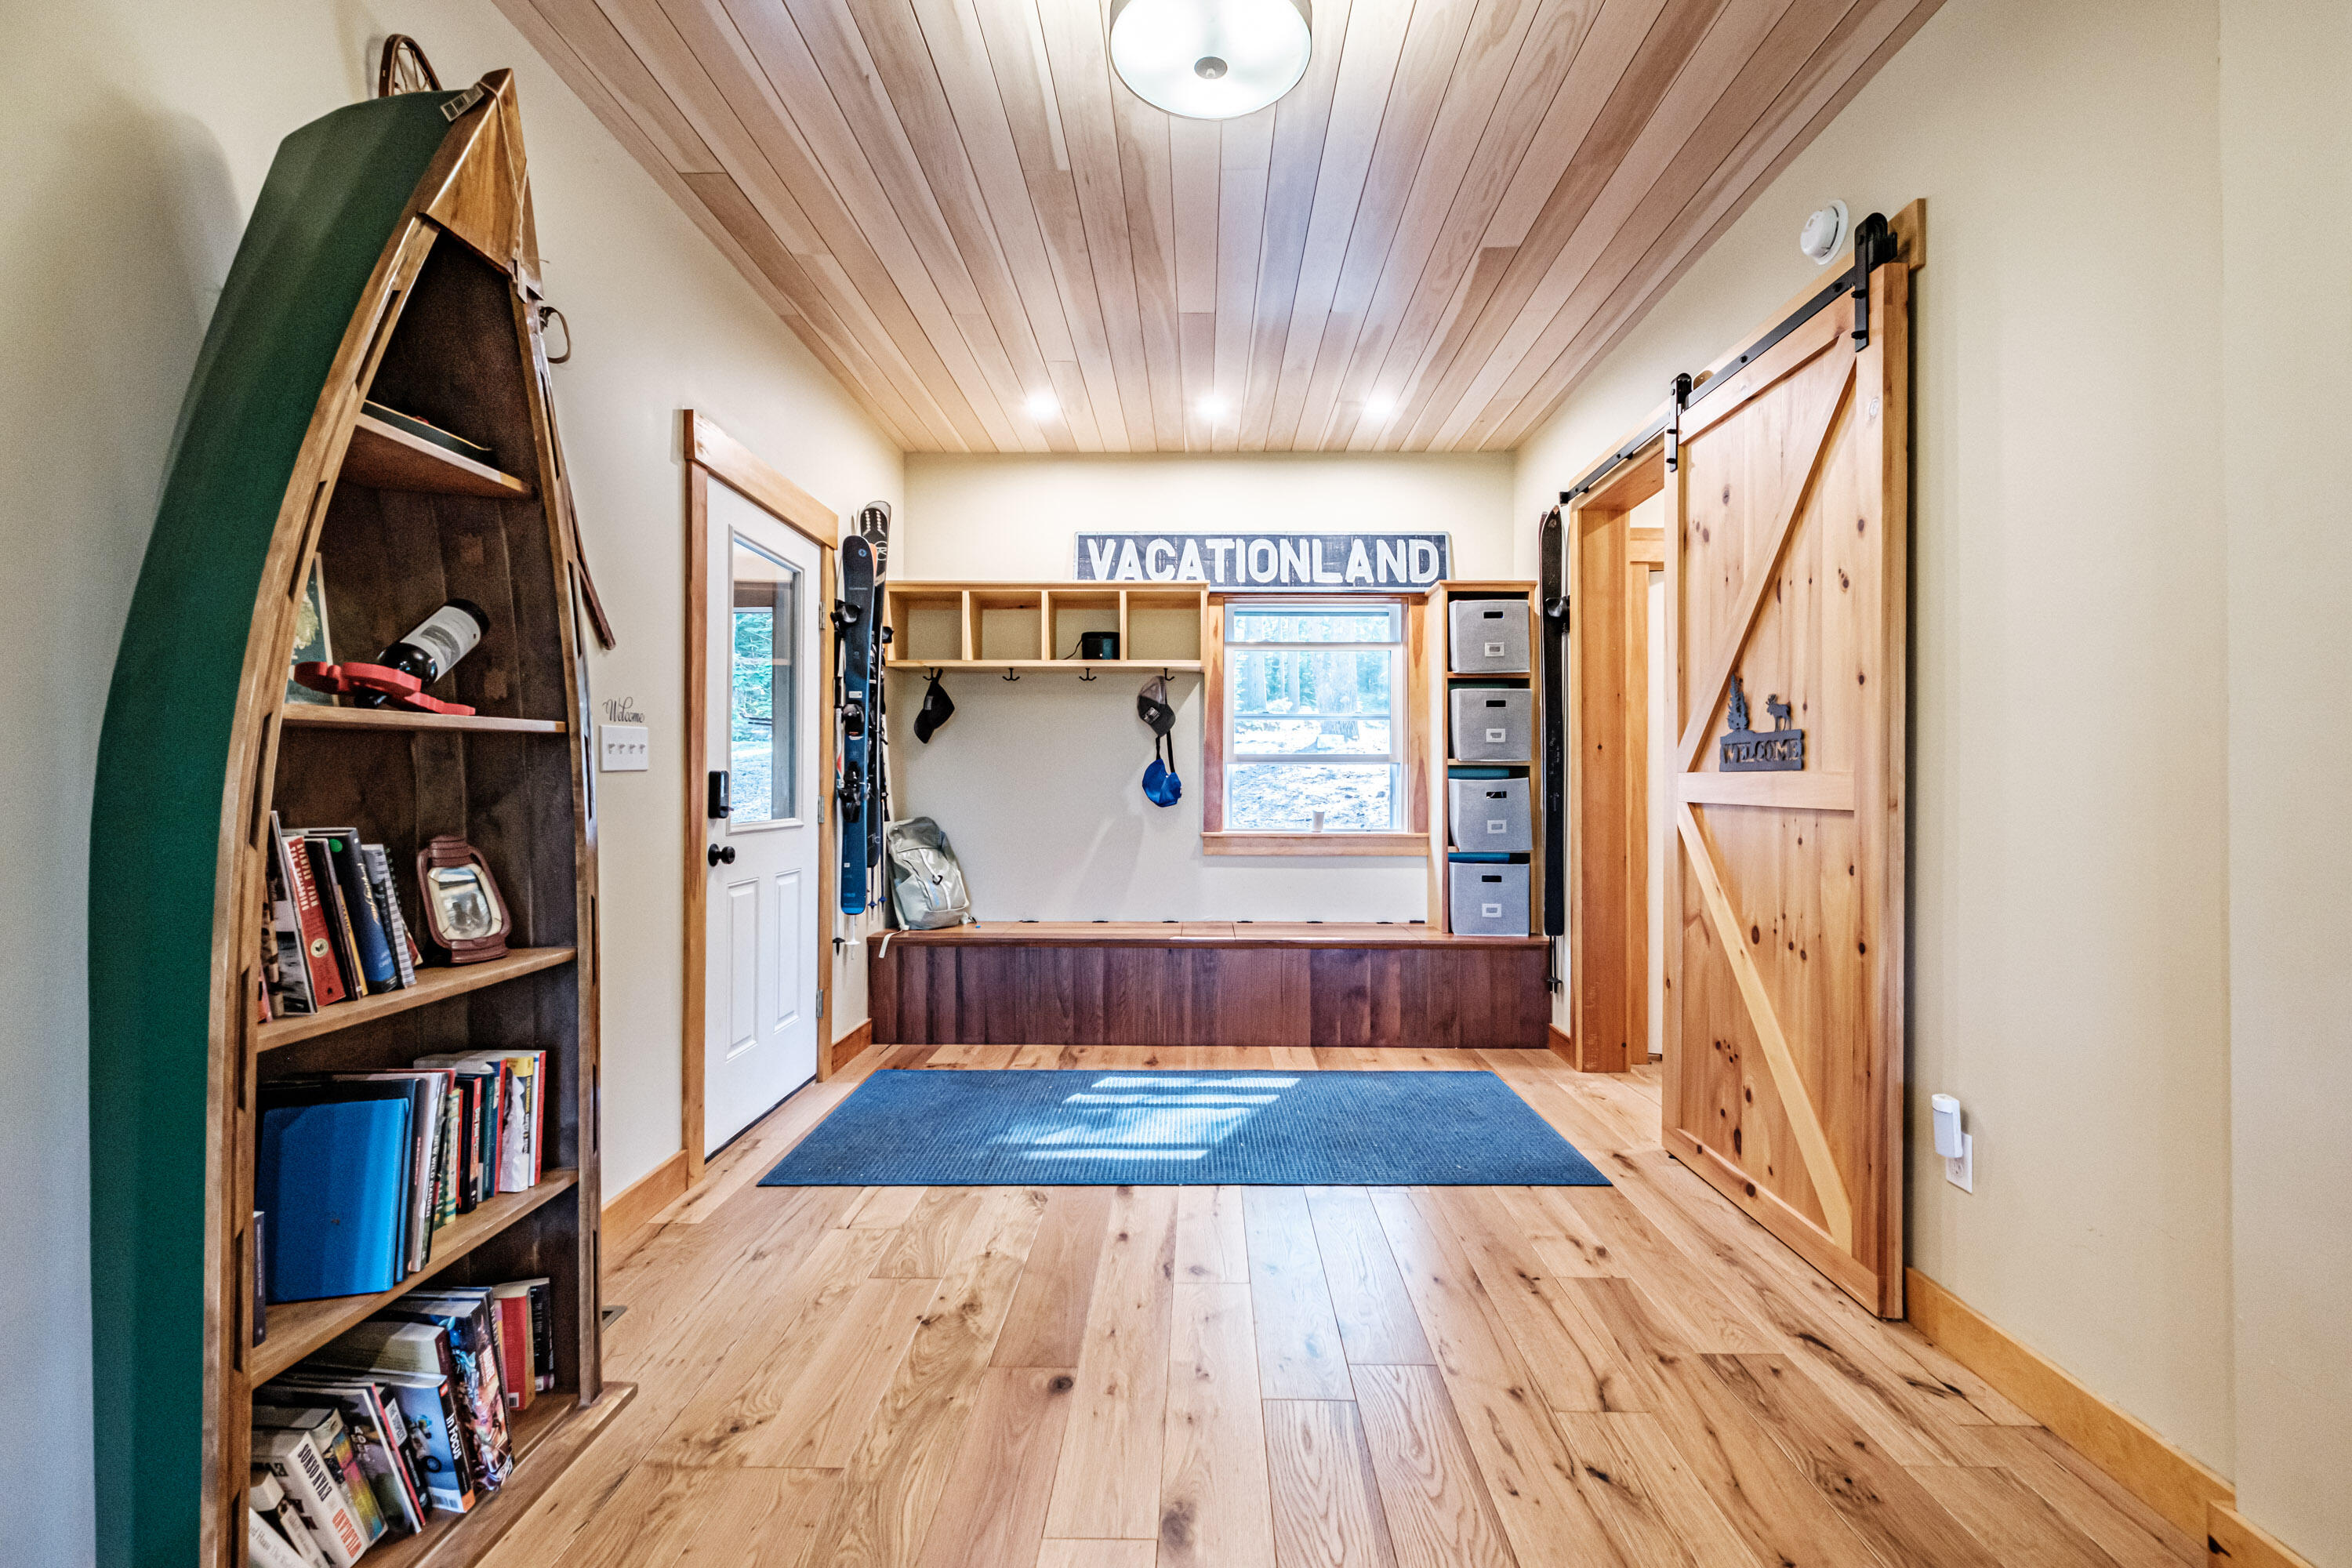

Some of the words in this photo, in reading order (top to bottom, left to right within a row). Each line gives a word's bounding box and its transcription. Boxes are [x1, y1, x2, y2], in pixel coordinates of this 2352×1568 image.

[1087, 538, 1440, 583] VACATIONLAND
[602, 696, 645, 723] Welcome
[1723, 739, 1799, 764] WELCOME
[297, 1443, 321, 1479] OSNOS
[448, 1425, 462, 1461] FOCUS
[310, 1470, 332, 1502] EVAN
[332, 1508, 361, 1559] WILDLAND
